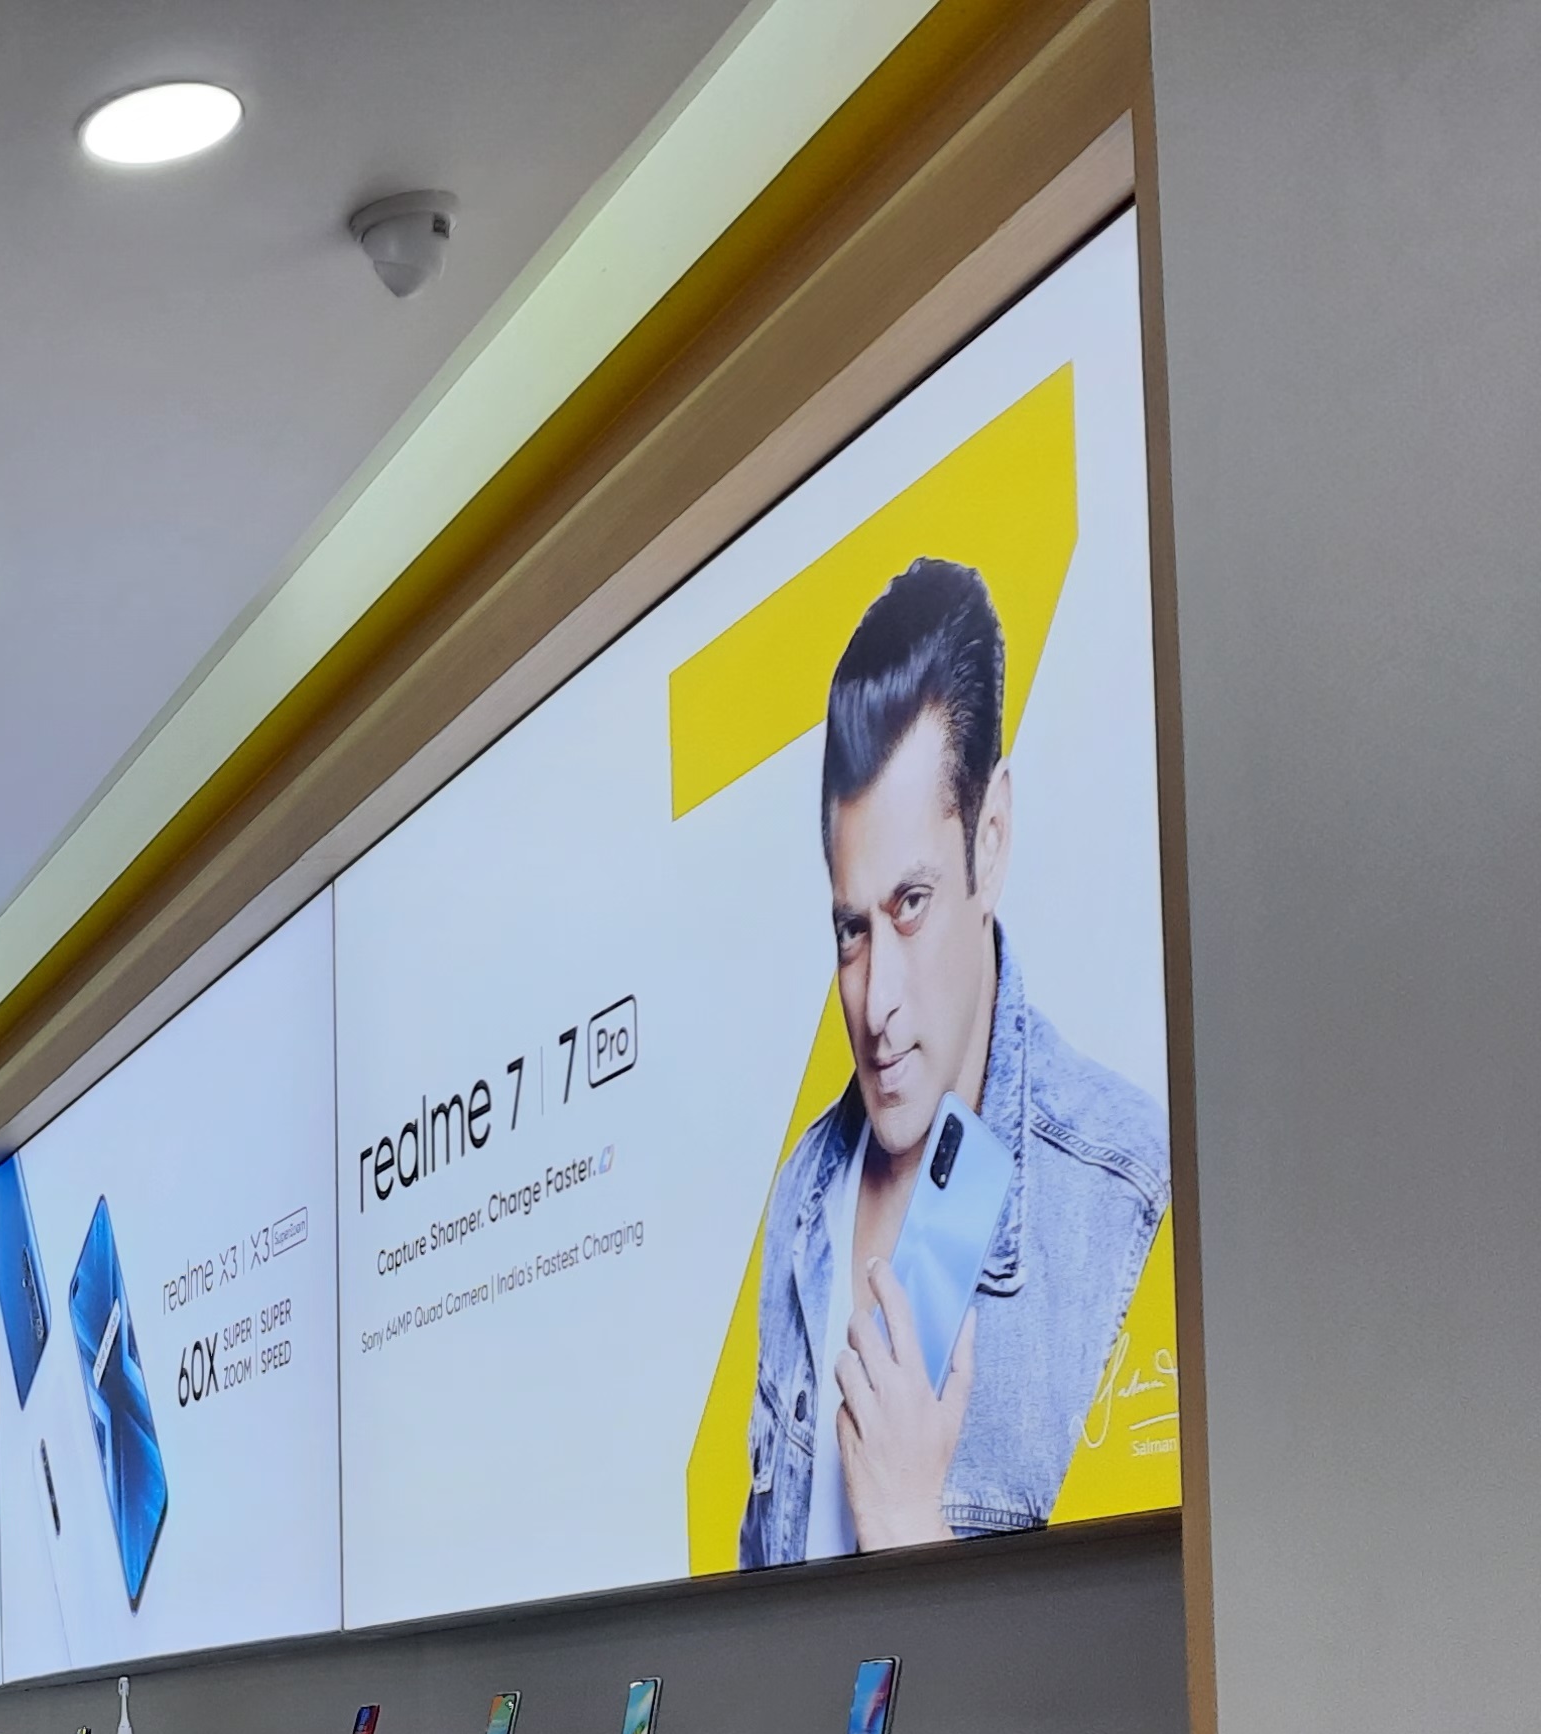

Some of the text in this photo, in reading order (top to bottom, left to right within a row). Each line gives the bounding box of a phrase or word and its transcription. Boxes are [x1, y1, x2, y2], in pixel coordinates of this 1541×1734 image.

[360, 1025, 629, 1214] realme 7 7 Pro
[377, 1154, 597, 1277] Capture Sharper. Charge Faster.
[163, 1258, 214, 1315] realme
[219, 1246, 237, 1287] X3
[250, 1226, 270, 1270] X3
[361, 1219, 645, 1354] Sony 64MP Quad Camera India's Fastest Charging
[223, 1316, 252, 1351] SUPER
[260, 1297, 292, 1334] SUPER
[178, 1331, 220, 1408] 60X
[223, 1355, 252, 1390] ZOOM
[261, 1340, 292, 1374] SPEED
[1132, 1436, 1178, 1458] Salman
